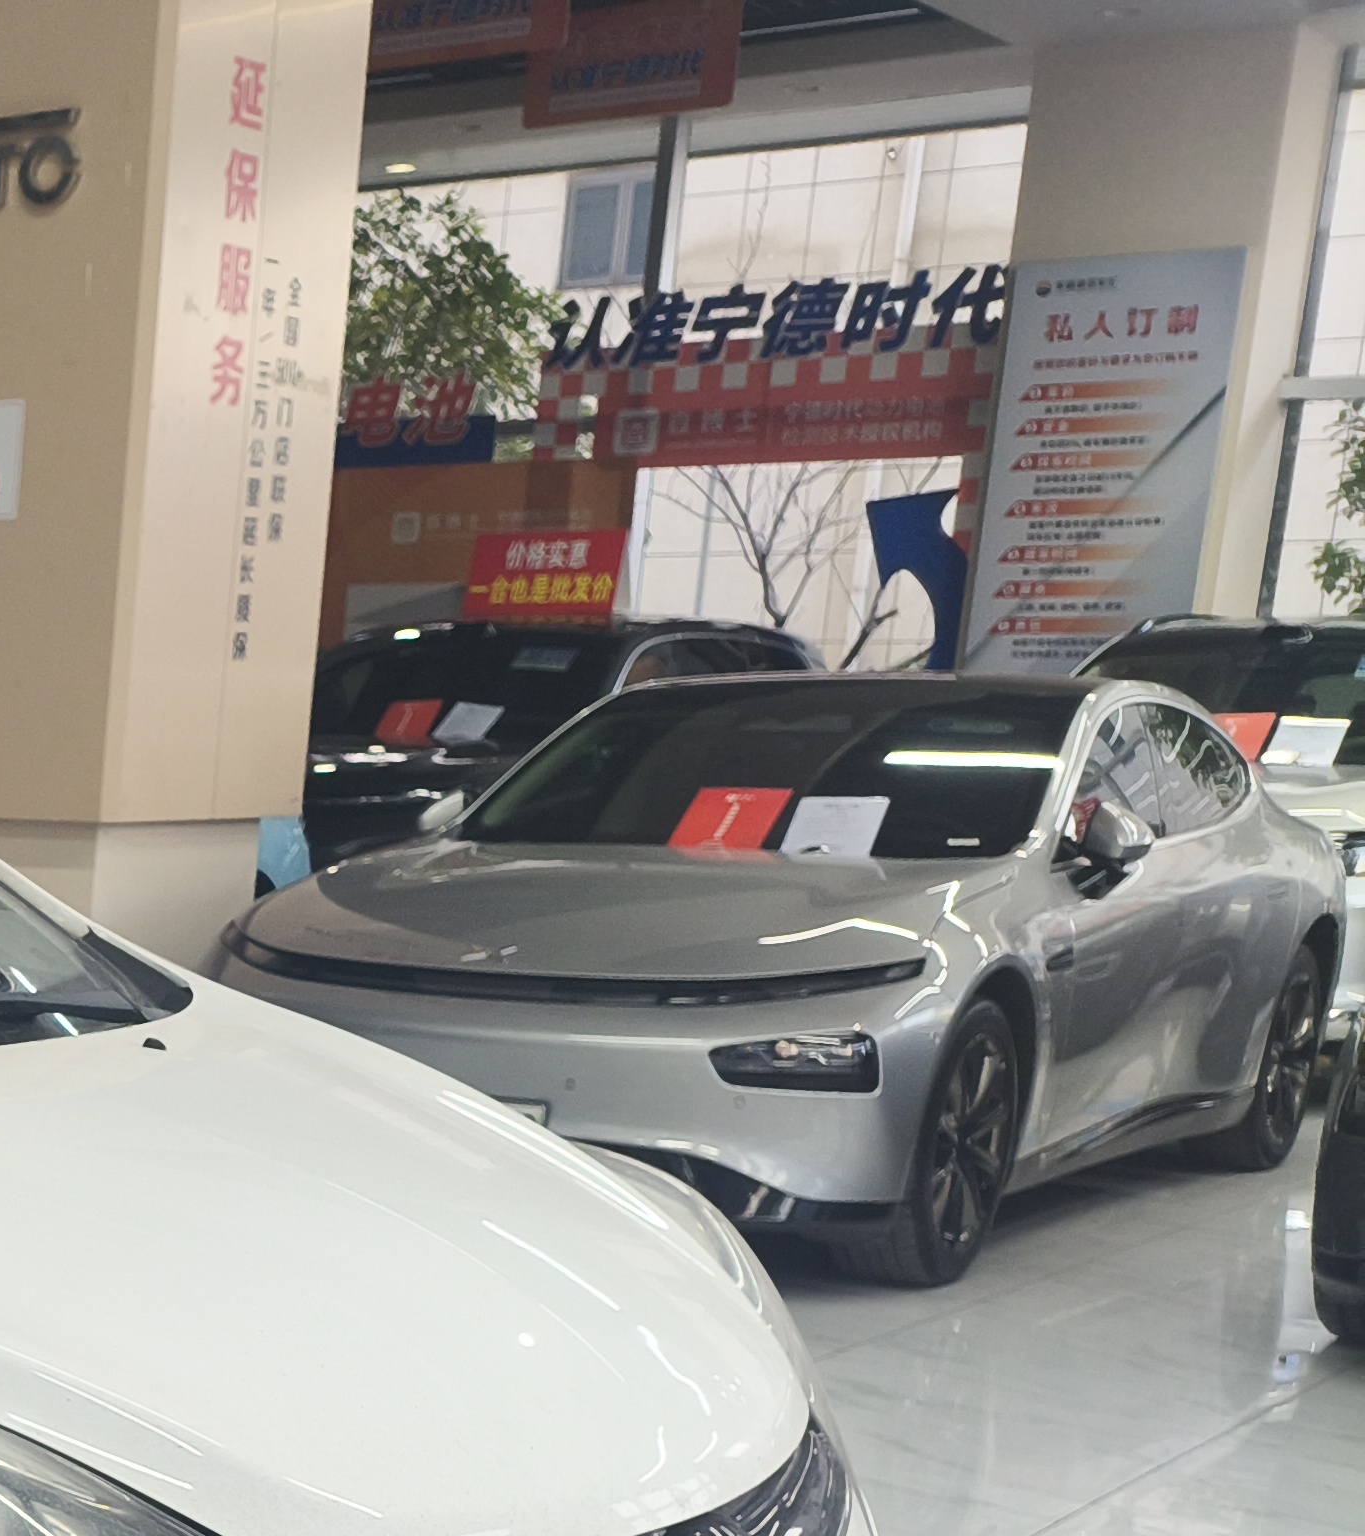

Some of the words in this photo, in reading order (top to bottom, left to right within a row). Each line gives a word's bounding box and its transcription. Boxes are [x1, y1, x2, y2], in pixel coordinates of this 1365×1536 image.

[209, 55, 267, 406] 延保服务
[543, 263, 1007, 369] 认准宁德时代
[340, 368, 479, 447] 电池
[505, 538, 590, 570] 价格实惠
